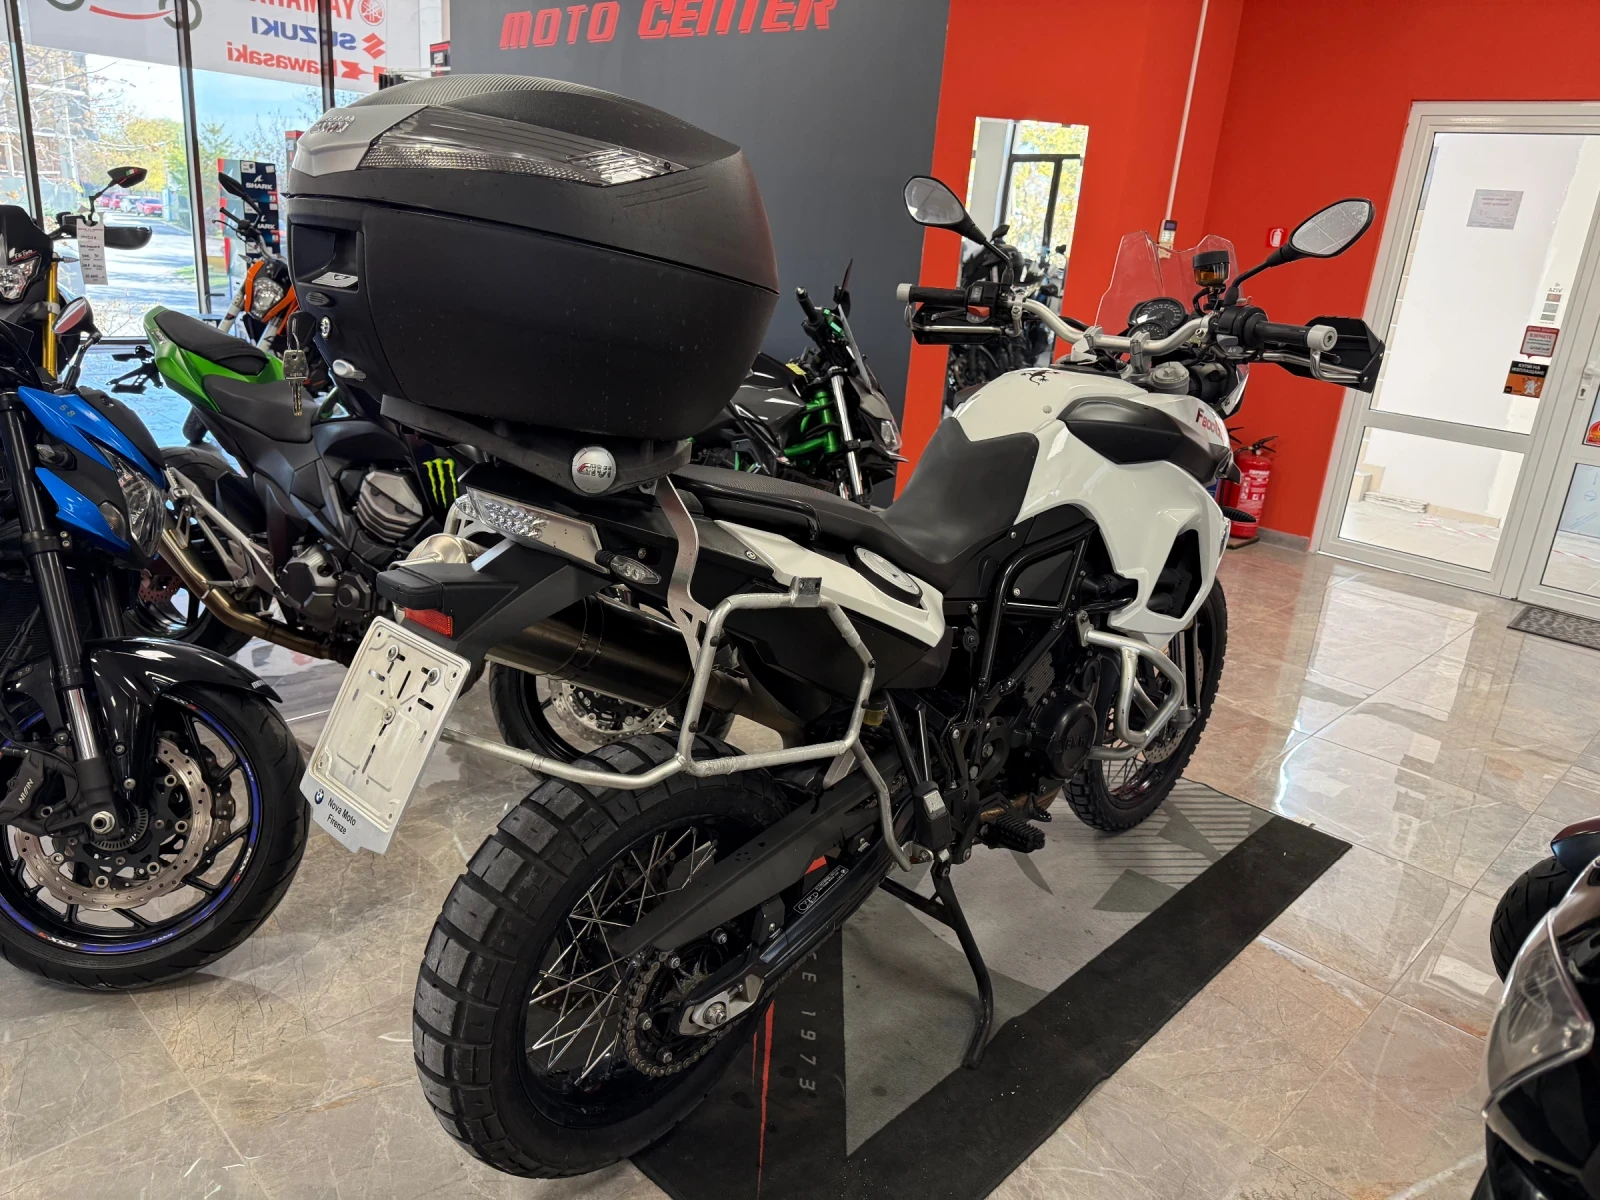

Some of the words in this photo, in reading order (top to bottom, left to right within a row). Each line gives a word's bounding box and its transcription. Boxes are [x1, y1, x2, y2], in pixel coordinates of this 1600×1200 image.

[500, 1, 620, 50] MOTO
[638, 0, 837, 39] CENTER
[326, 813, 347, 835] Firenze
[327, 797, 342, 815] Nova
[341, 809, 357, 826] Moto
[799, 1010, 817, 1091] 1973
